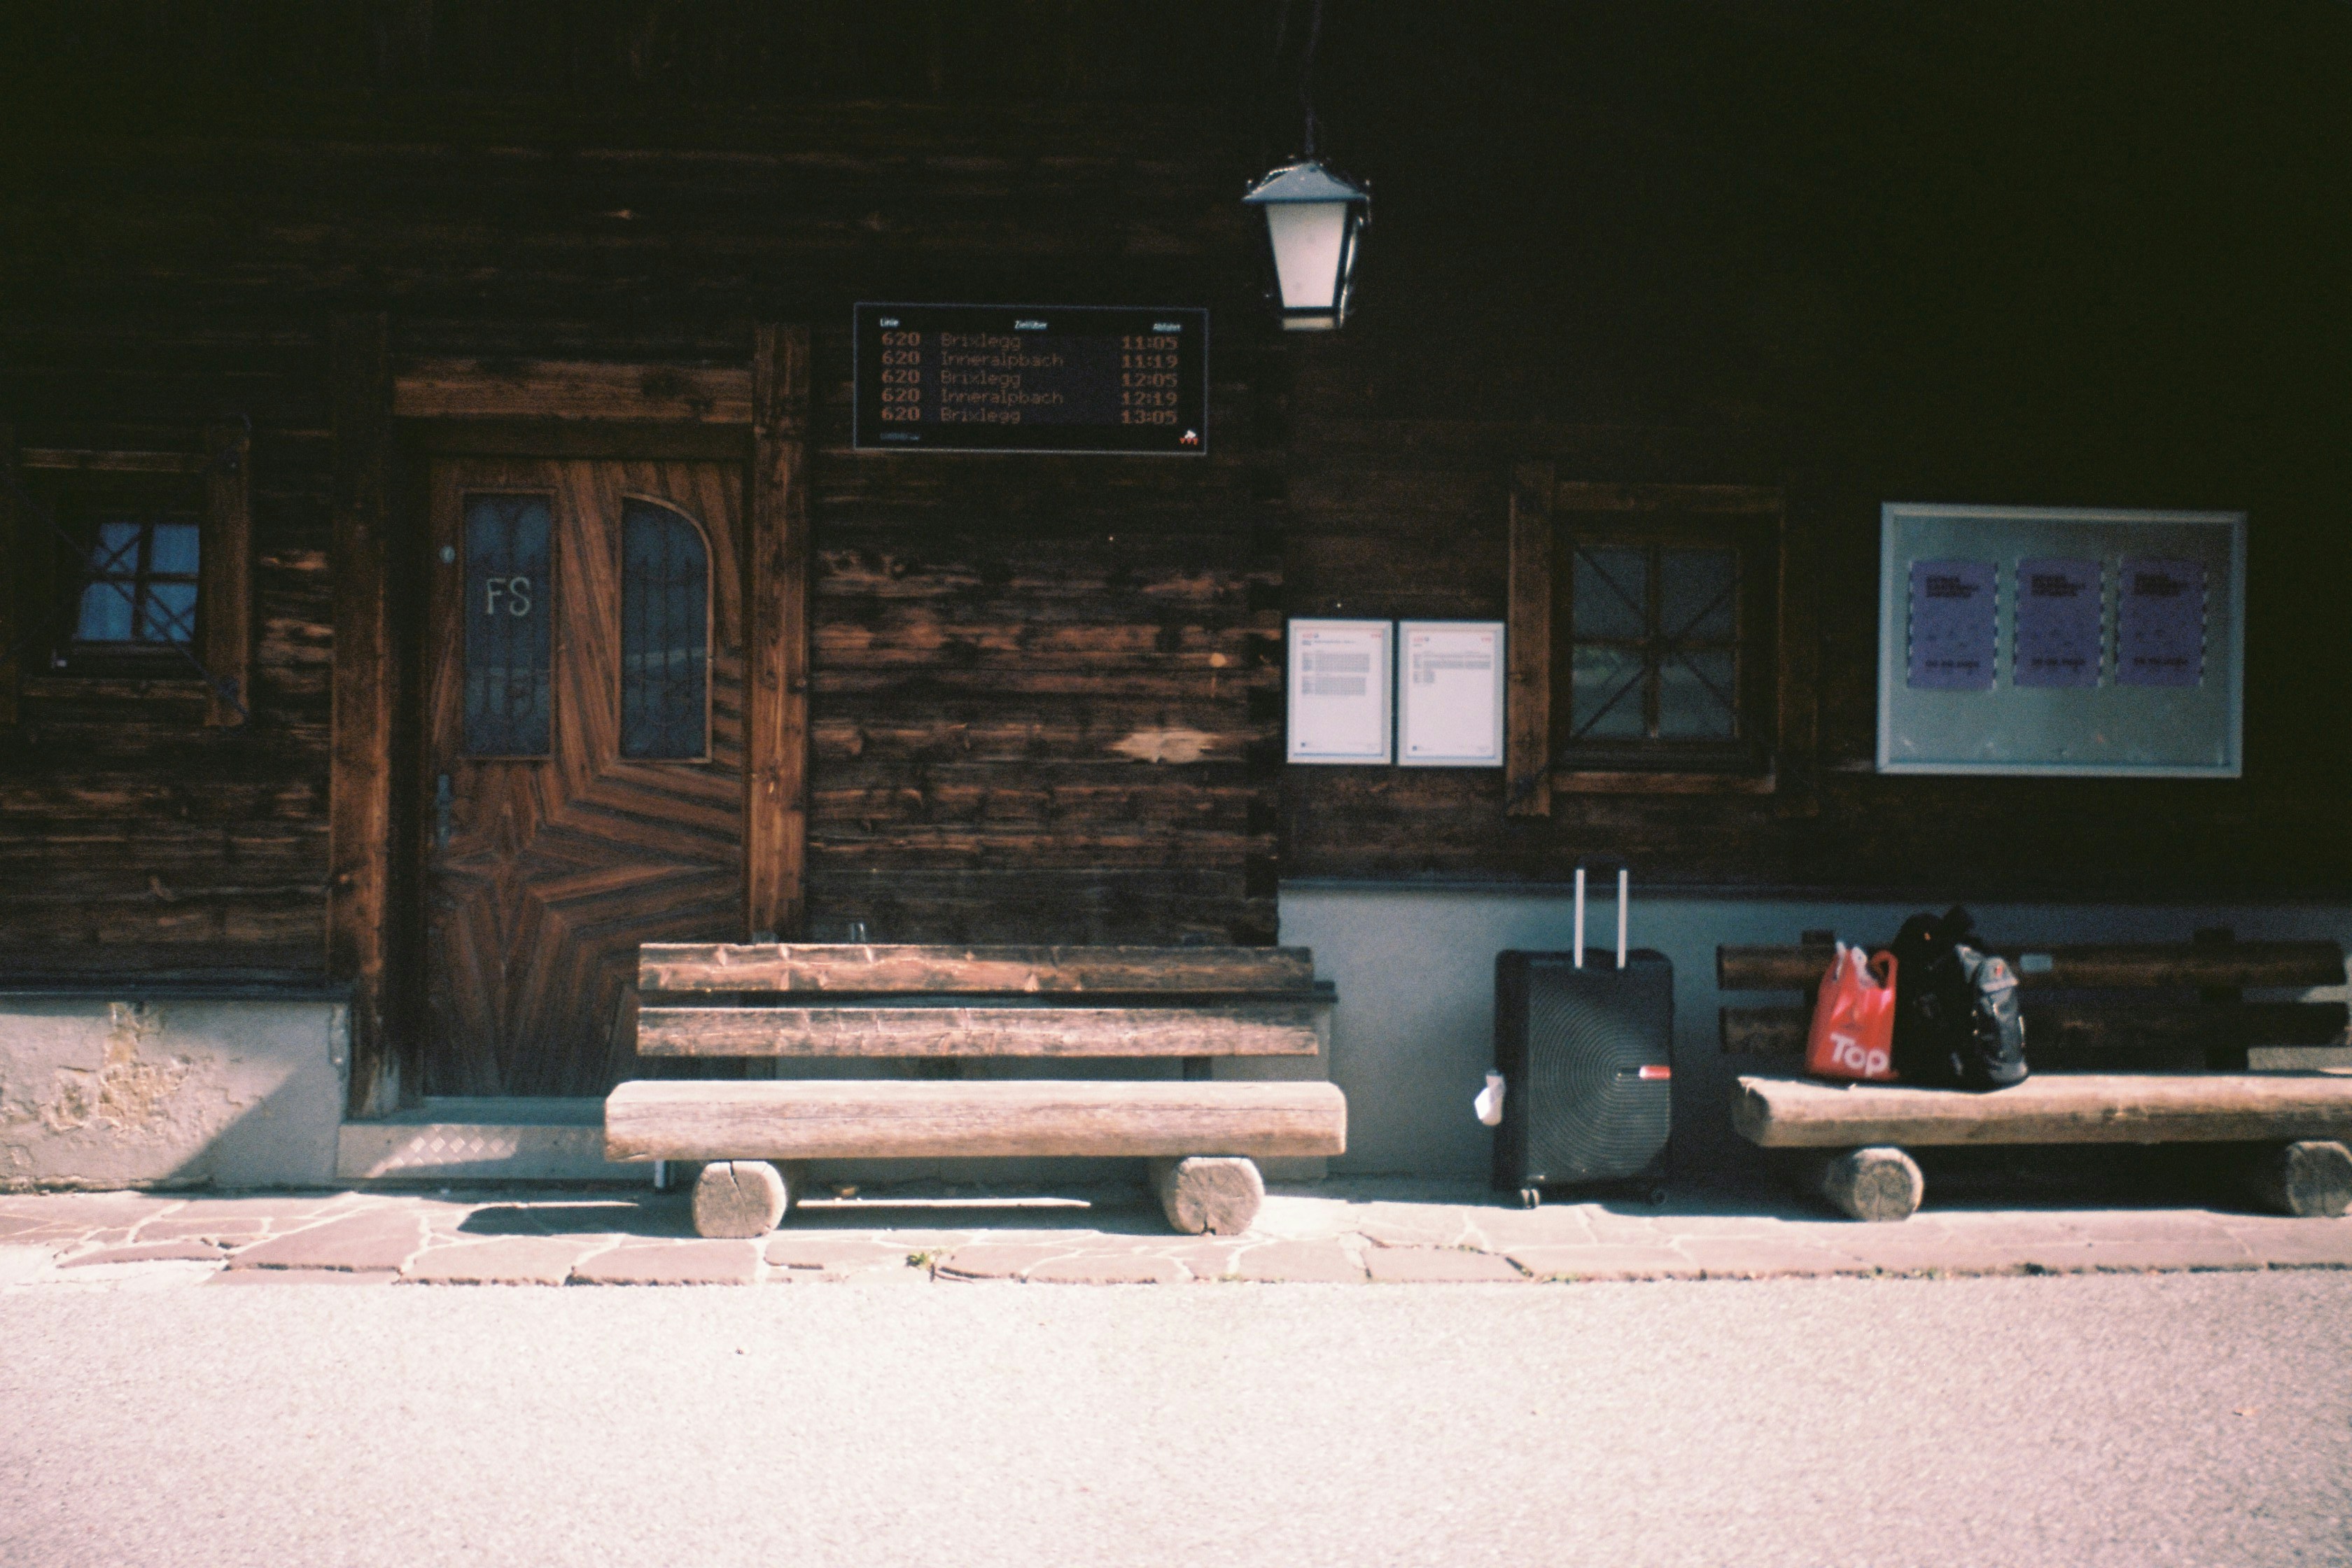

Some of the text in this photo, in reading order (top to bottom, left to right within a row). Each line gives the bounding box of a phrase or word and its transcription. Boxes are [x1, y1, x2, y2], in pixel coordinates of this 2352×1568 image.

[881, 332, 1177, 351] 620 Brixlegg 11:05
[881, 350, 1177, 369] 620 Inneralpbach 11:19
[881, 369, 1177, 388] 620 Brixlegg 12:05
[881, 388, 1177, 406] 620 Inneralpbach 12:19
[881, 407, 1177, 424] 620 Brixlegg 13:05
[486, 577, 531, 616] FS
[1830, 1032, 1889, 1077] Top
